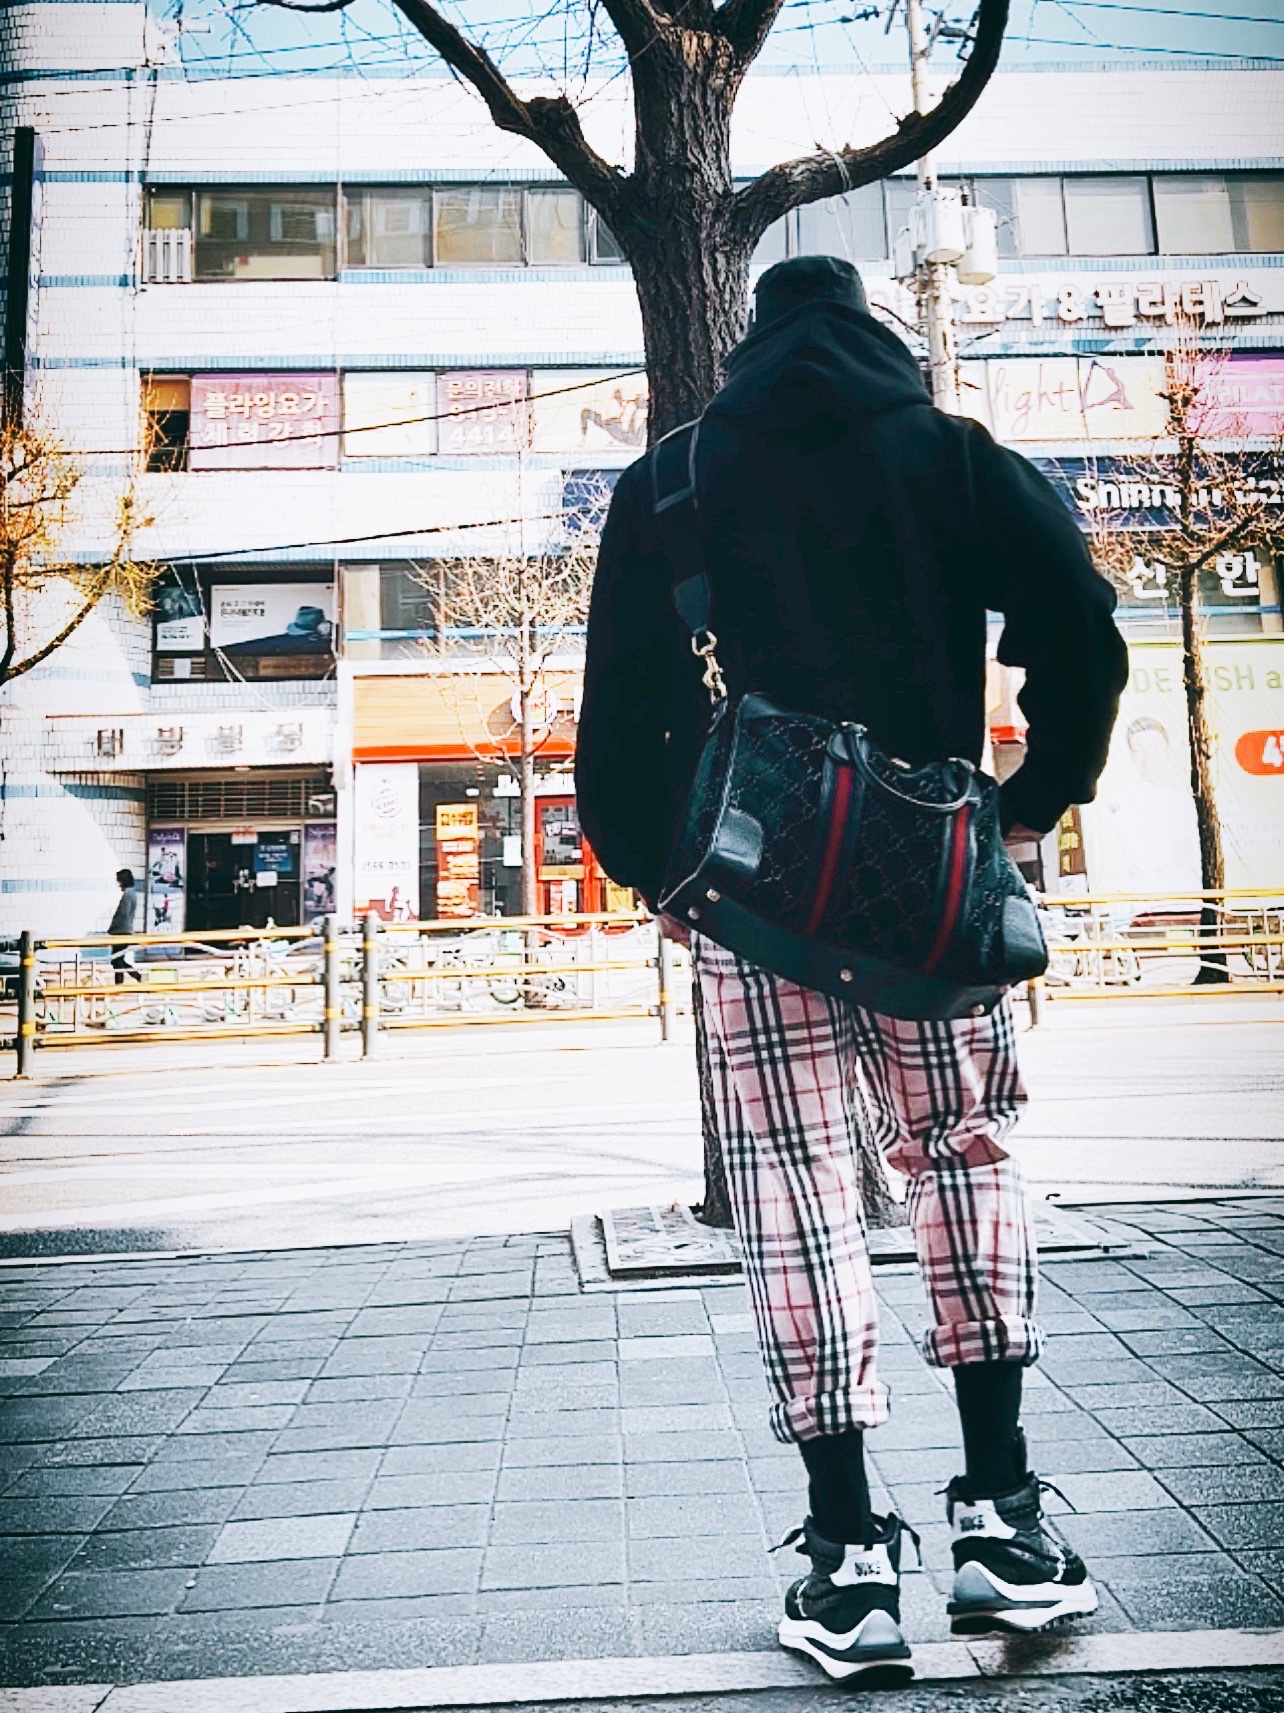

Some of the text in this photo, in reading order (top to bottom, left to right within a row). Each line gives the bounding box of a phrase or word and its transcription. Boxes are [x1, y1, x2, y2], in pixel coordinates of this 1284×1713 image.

[1057, 289, 1087, 322] &
[1093, 281, 1268, 328] 필라테스
[202, 391, 330, 420] 플라잉요가
